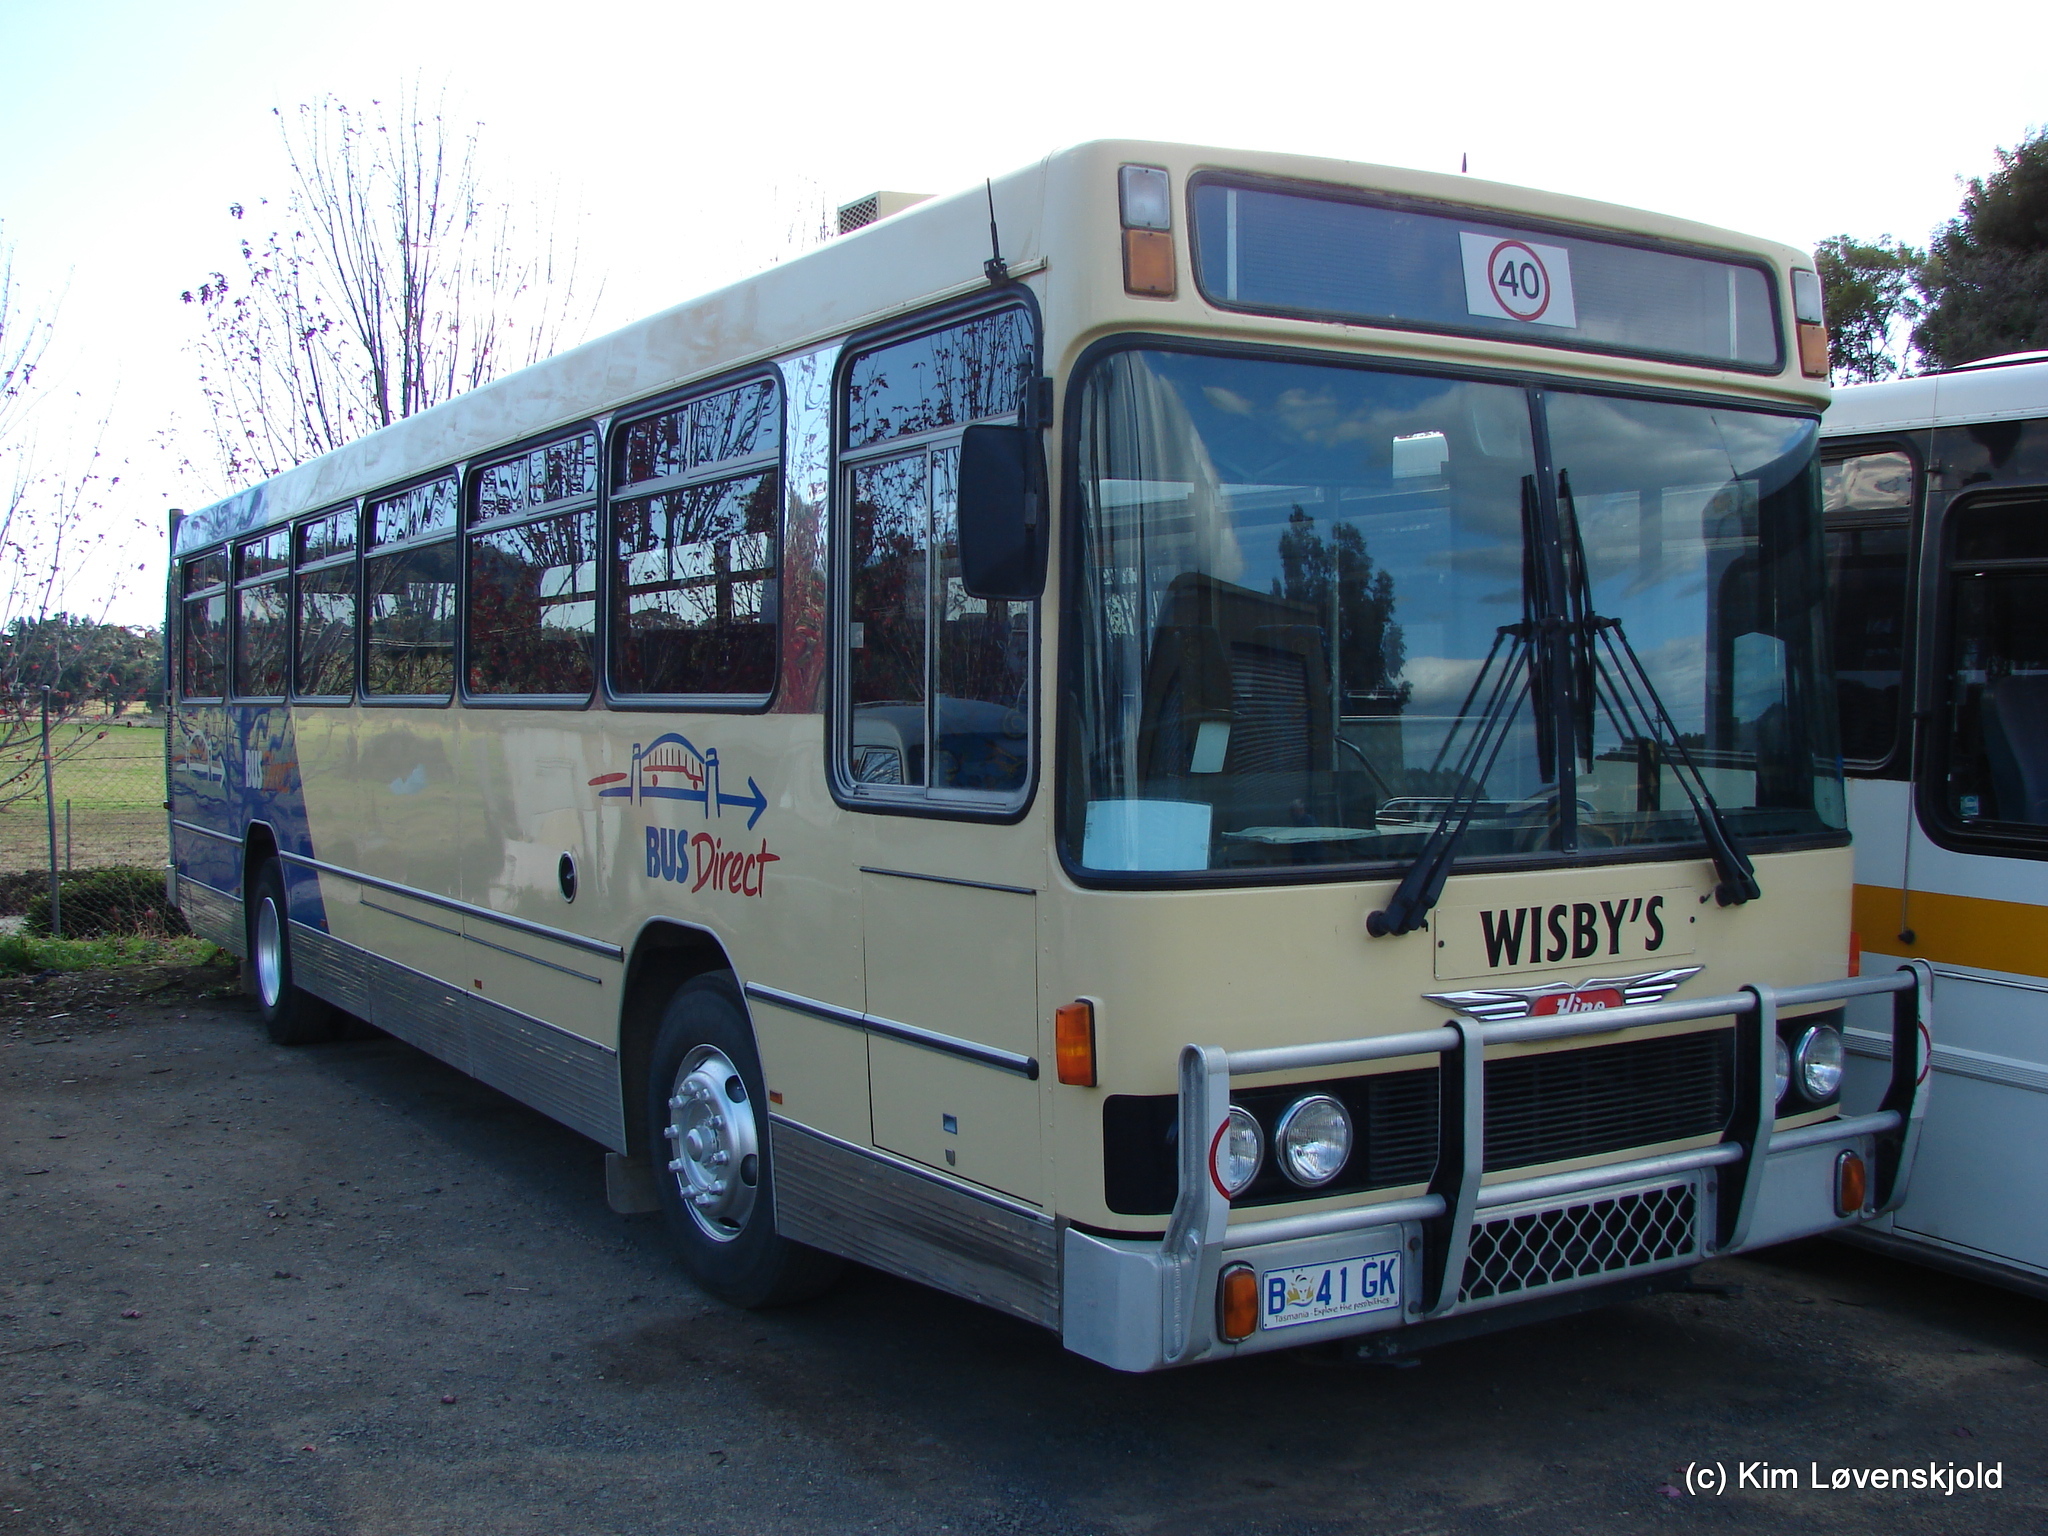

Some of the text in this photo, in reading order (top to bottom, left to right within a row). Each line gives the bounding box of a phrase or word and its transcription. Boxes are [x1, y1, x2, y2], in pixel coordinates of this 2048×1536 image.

[1498, 260, 1540, 300] 40
[645, 826, 780, 898] BUS Direct
[1480, 895, 1664, 968] WISBY'S
[1268, 1259, 1396, 1315] B 41 GK
[1274, 1311, 1310, 1323] Tasmania
[1313, 1304, 1338, 1317] Explore
[1339, 1301, 1352, 1311] the
[1353, 1297, 1390, 1310] possibilities
